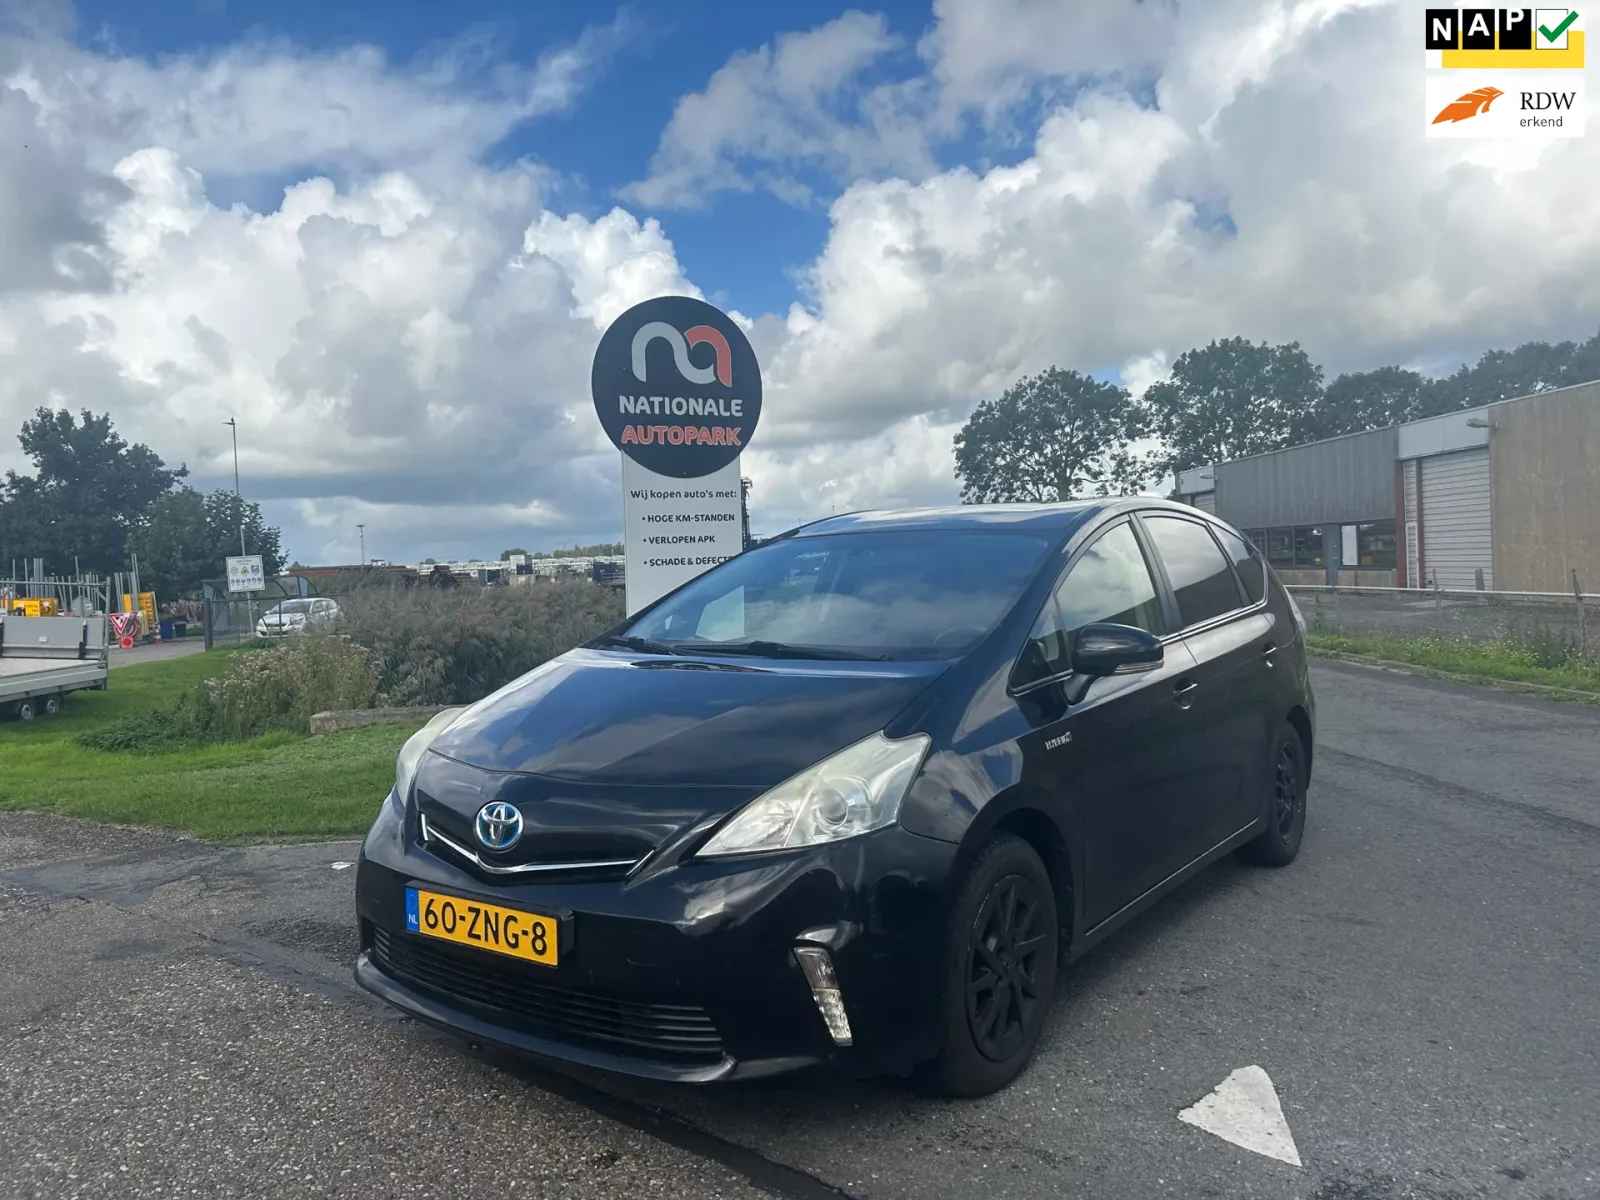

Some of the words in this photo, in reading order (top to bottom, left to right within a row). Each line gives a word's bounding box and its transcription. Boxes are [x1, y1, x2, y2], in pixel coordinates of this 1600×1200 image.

[619, 395, 743, 417] NATIONALE
[621, 424, 742, 446] AUTOPARK
[630, 490, 648, 500] Wij
[650, 489, 681, 500] kopen
[684, 489, 713, 498] auto's
[715, 490, 737, 498] met:
[647, 514, 674, 523] HOGE
[675, 513, 735, 522] KM-STANDEN
[648, 536, 696, 544] VERLOPEN
[698, 535, 716, 543] APK
[649, 558, 686, 567] SCHADE
[687, 558, 694, 566] &
[408, 913, 418, 925] NL
[424, 898, 547, 956] 60-ZNG-8
